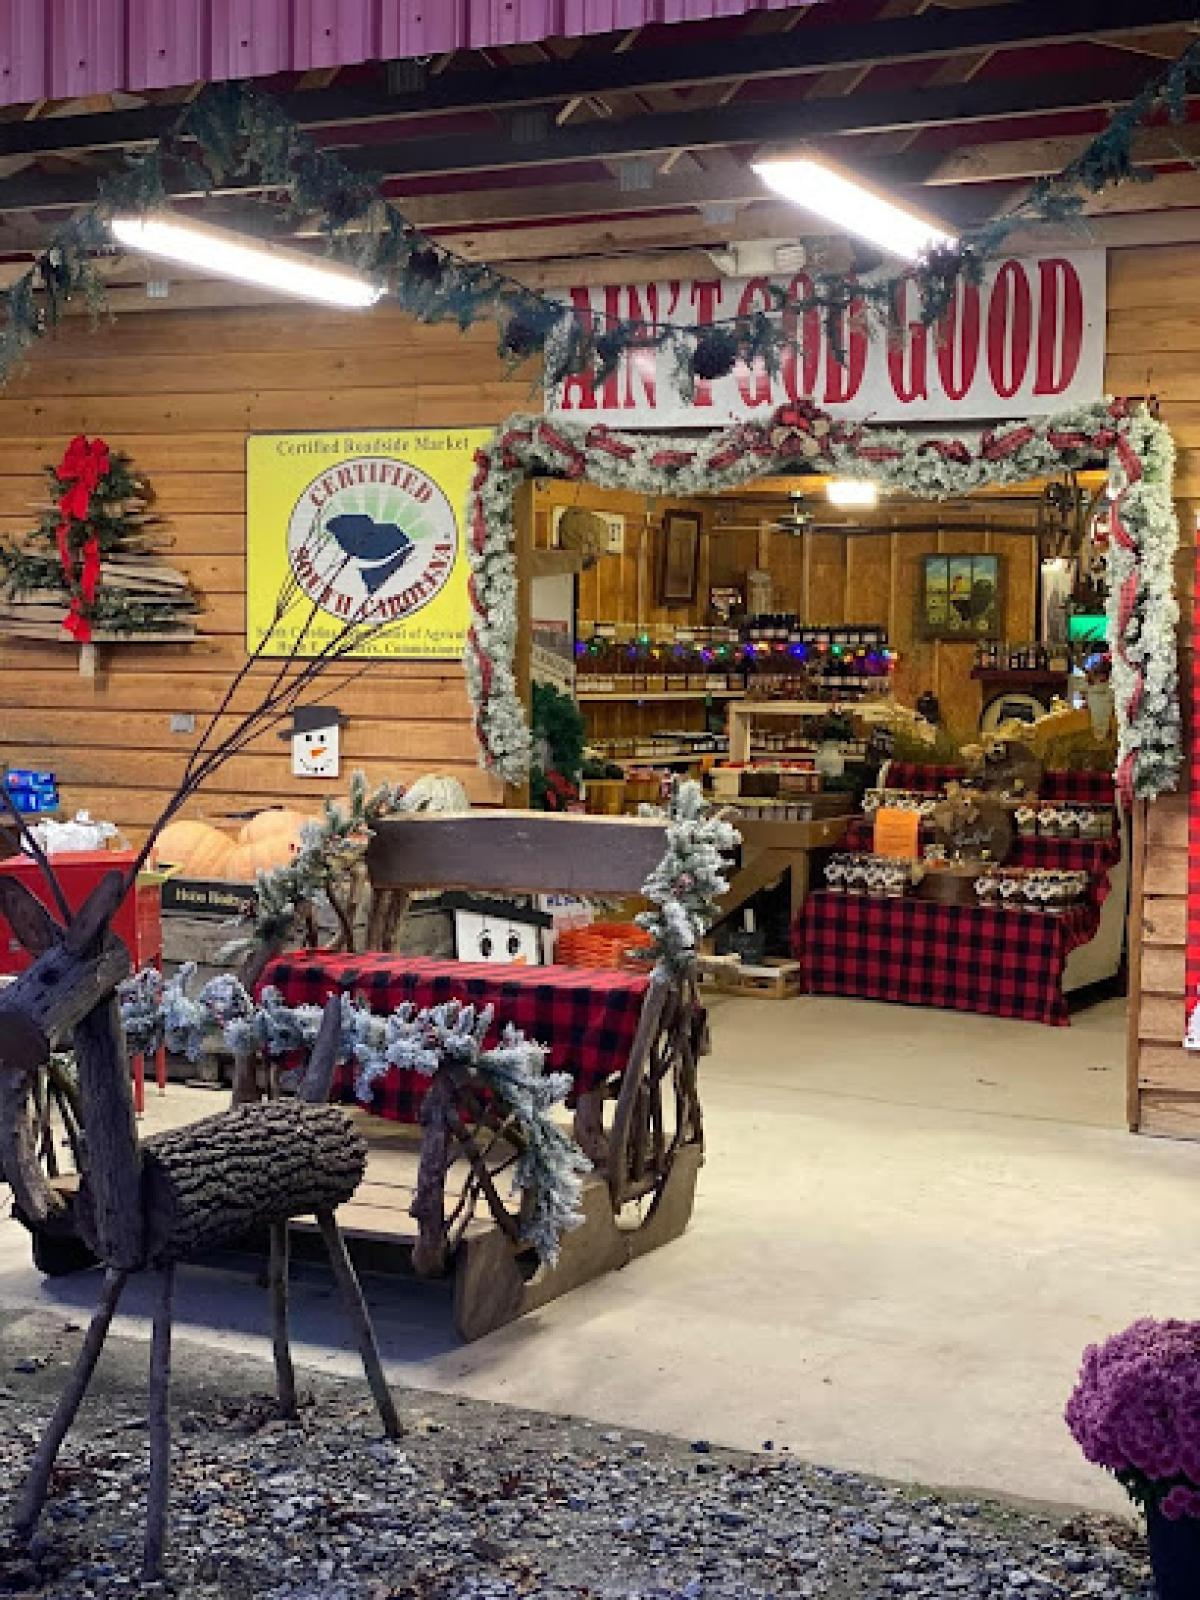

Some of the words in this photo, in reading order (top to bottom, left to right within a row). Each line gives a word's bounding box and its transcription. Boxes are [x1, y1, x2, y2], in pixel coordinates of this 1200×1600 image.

[561, 278, 722, 410] AIN'T
[887, 258, 1084, 403] GOOD
[414, 435, 470, 451] Market
[308, 463, 433, 507] CERTIFIED
